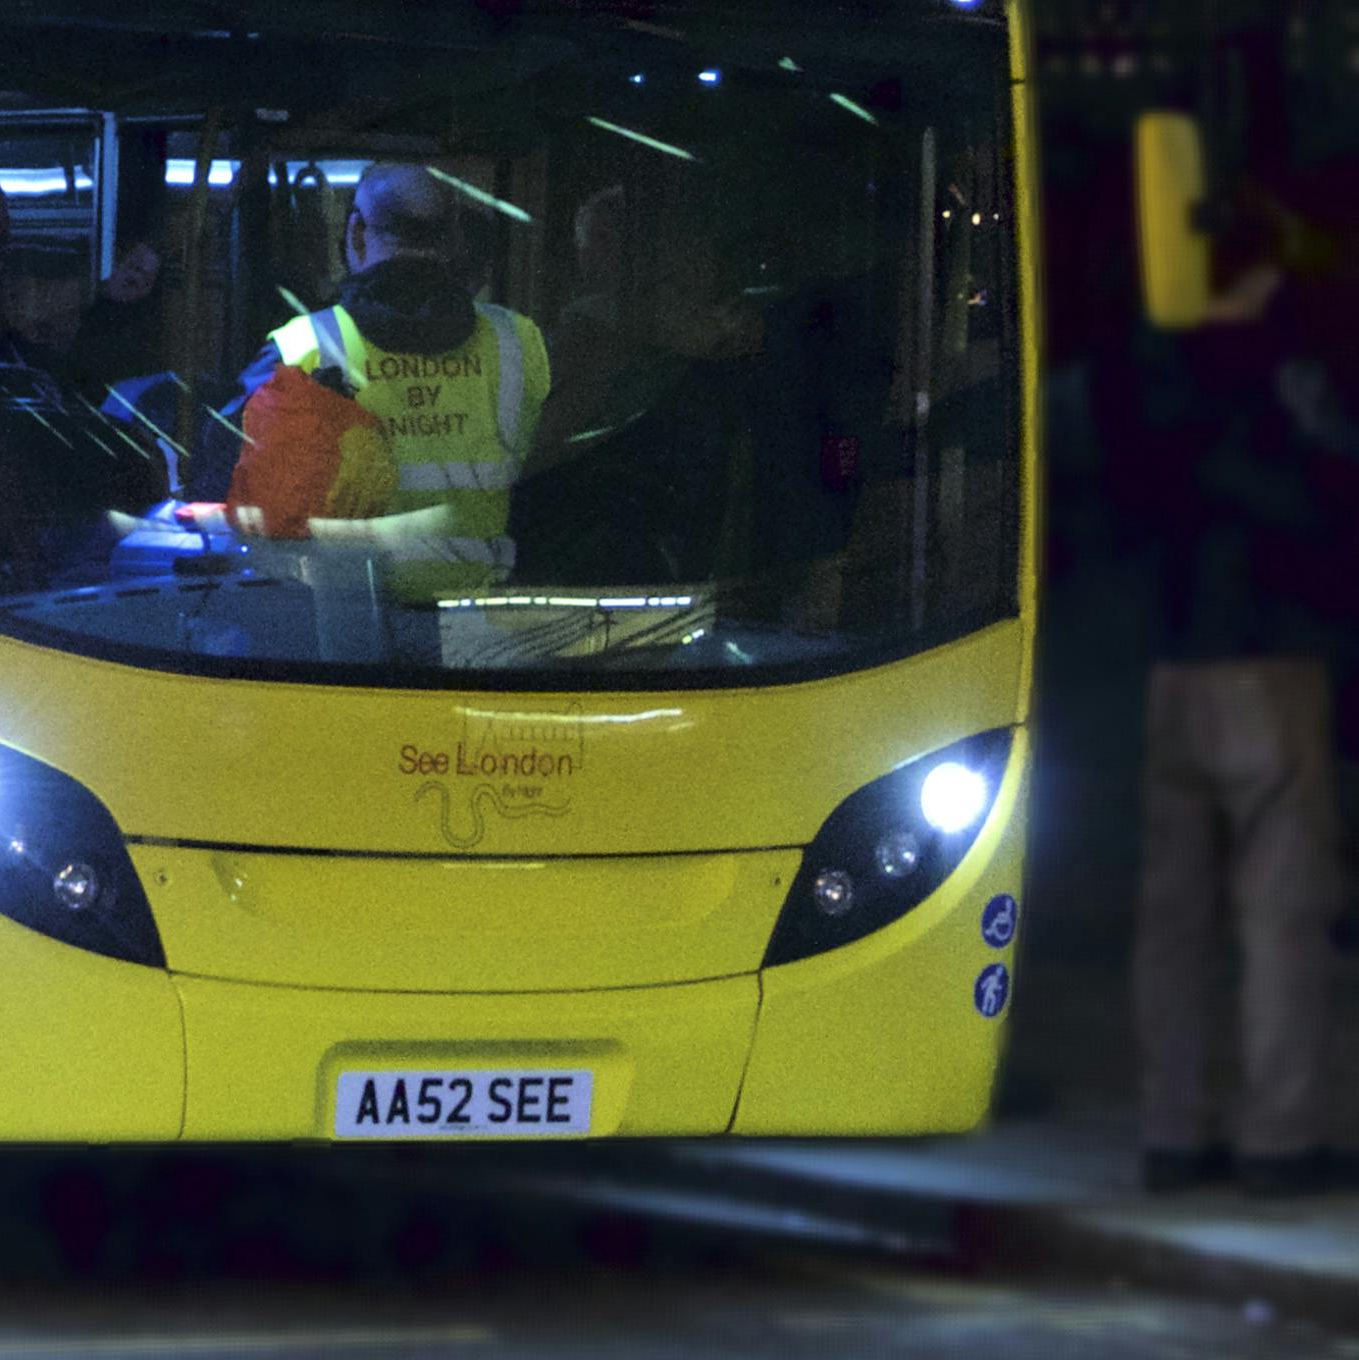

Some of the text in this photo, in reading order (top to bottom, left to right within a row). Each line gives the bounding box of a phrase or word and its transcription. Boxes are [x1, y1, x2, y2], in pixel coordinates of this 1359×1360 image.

[365, 353, 482, 381] LONDON
[407, 386, 441, 408] BY
[388, 413, 469, 437] NIGHT
[398, 741, 573, 777] See London
[355, 1076, 575, 1125] AA52 SEE
